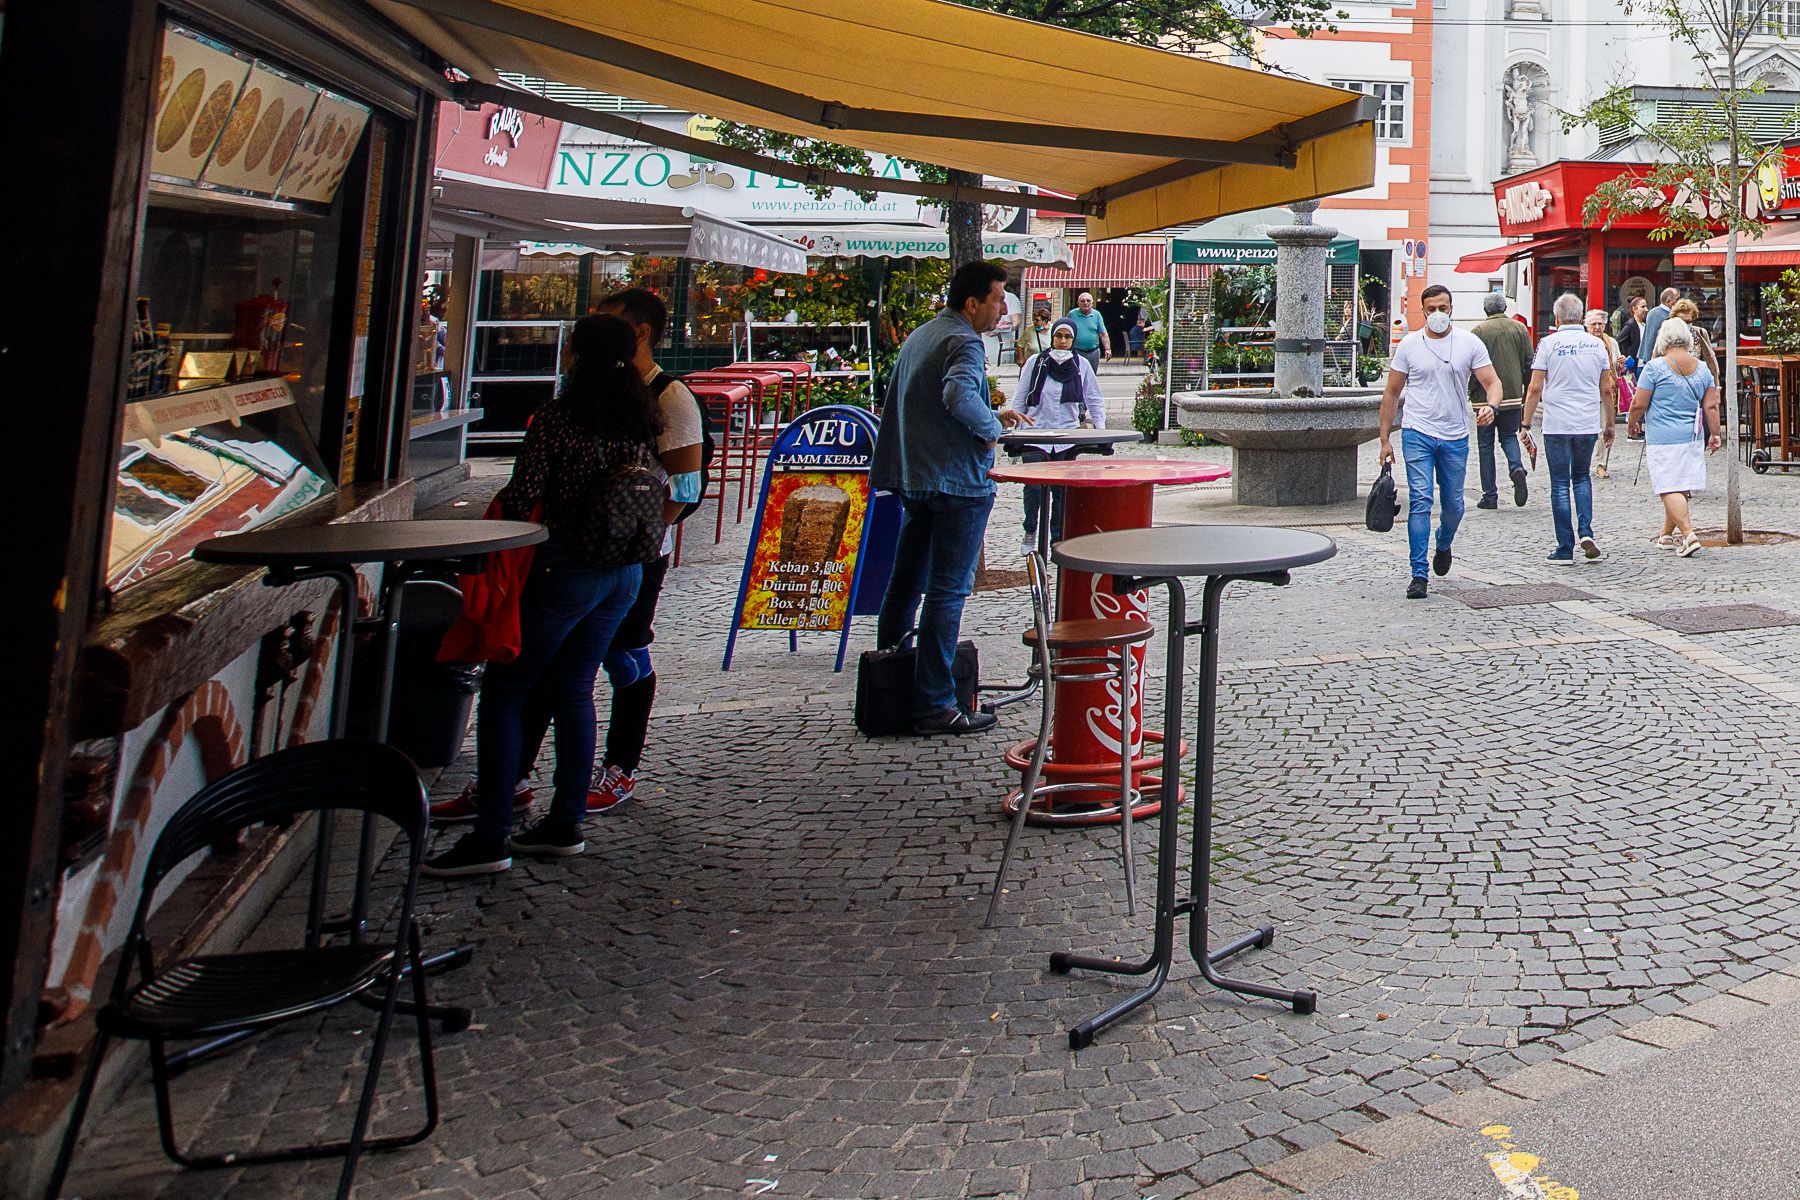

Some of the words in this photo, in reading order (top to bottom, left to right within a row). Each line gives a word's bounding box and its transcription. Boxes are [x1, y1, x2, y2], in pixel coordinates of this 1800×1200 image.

[556, 150, 672, 187] NZO
[751, 200, 897, 212] www.penzo-flora.at
[846, 238, 1018, 254] www.penzo-ra.at
[1197, 247, 1337, 261] www.penzoat
[792, 419, 858, 447] NEU
[778, 454, 821, 465] LAMM
[824, 454, 869, 465] KEBAP
[768, 561, 809, 574] Kebap
[761, 579, 807, 593] Dürüm
[768, 597, 794, 609] Box
[757, 613, 793, 626] Teller
